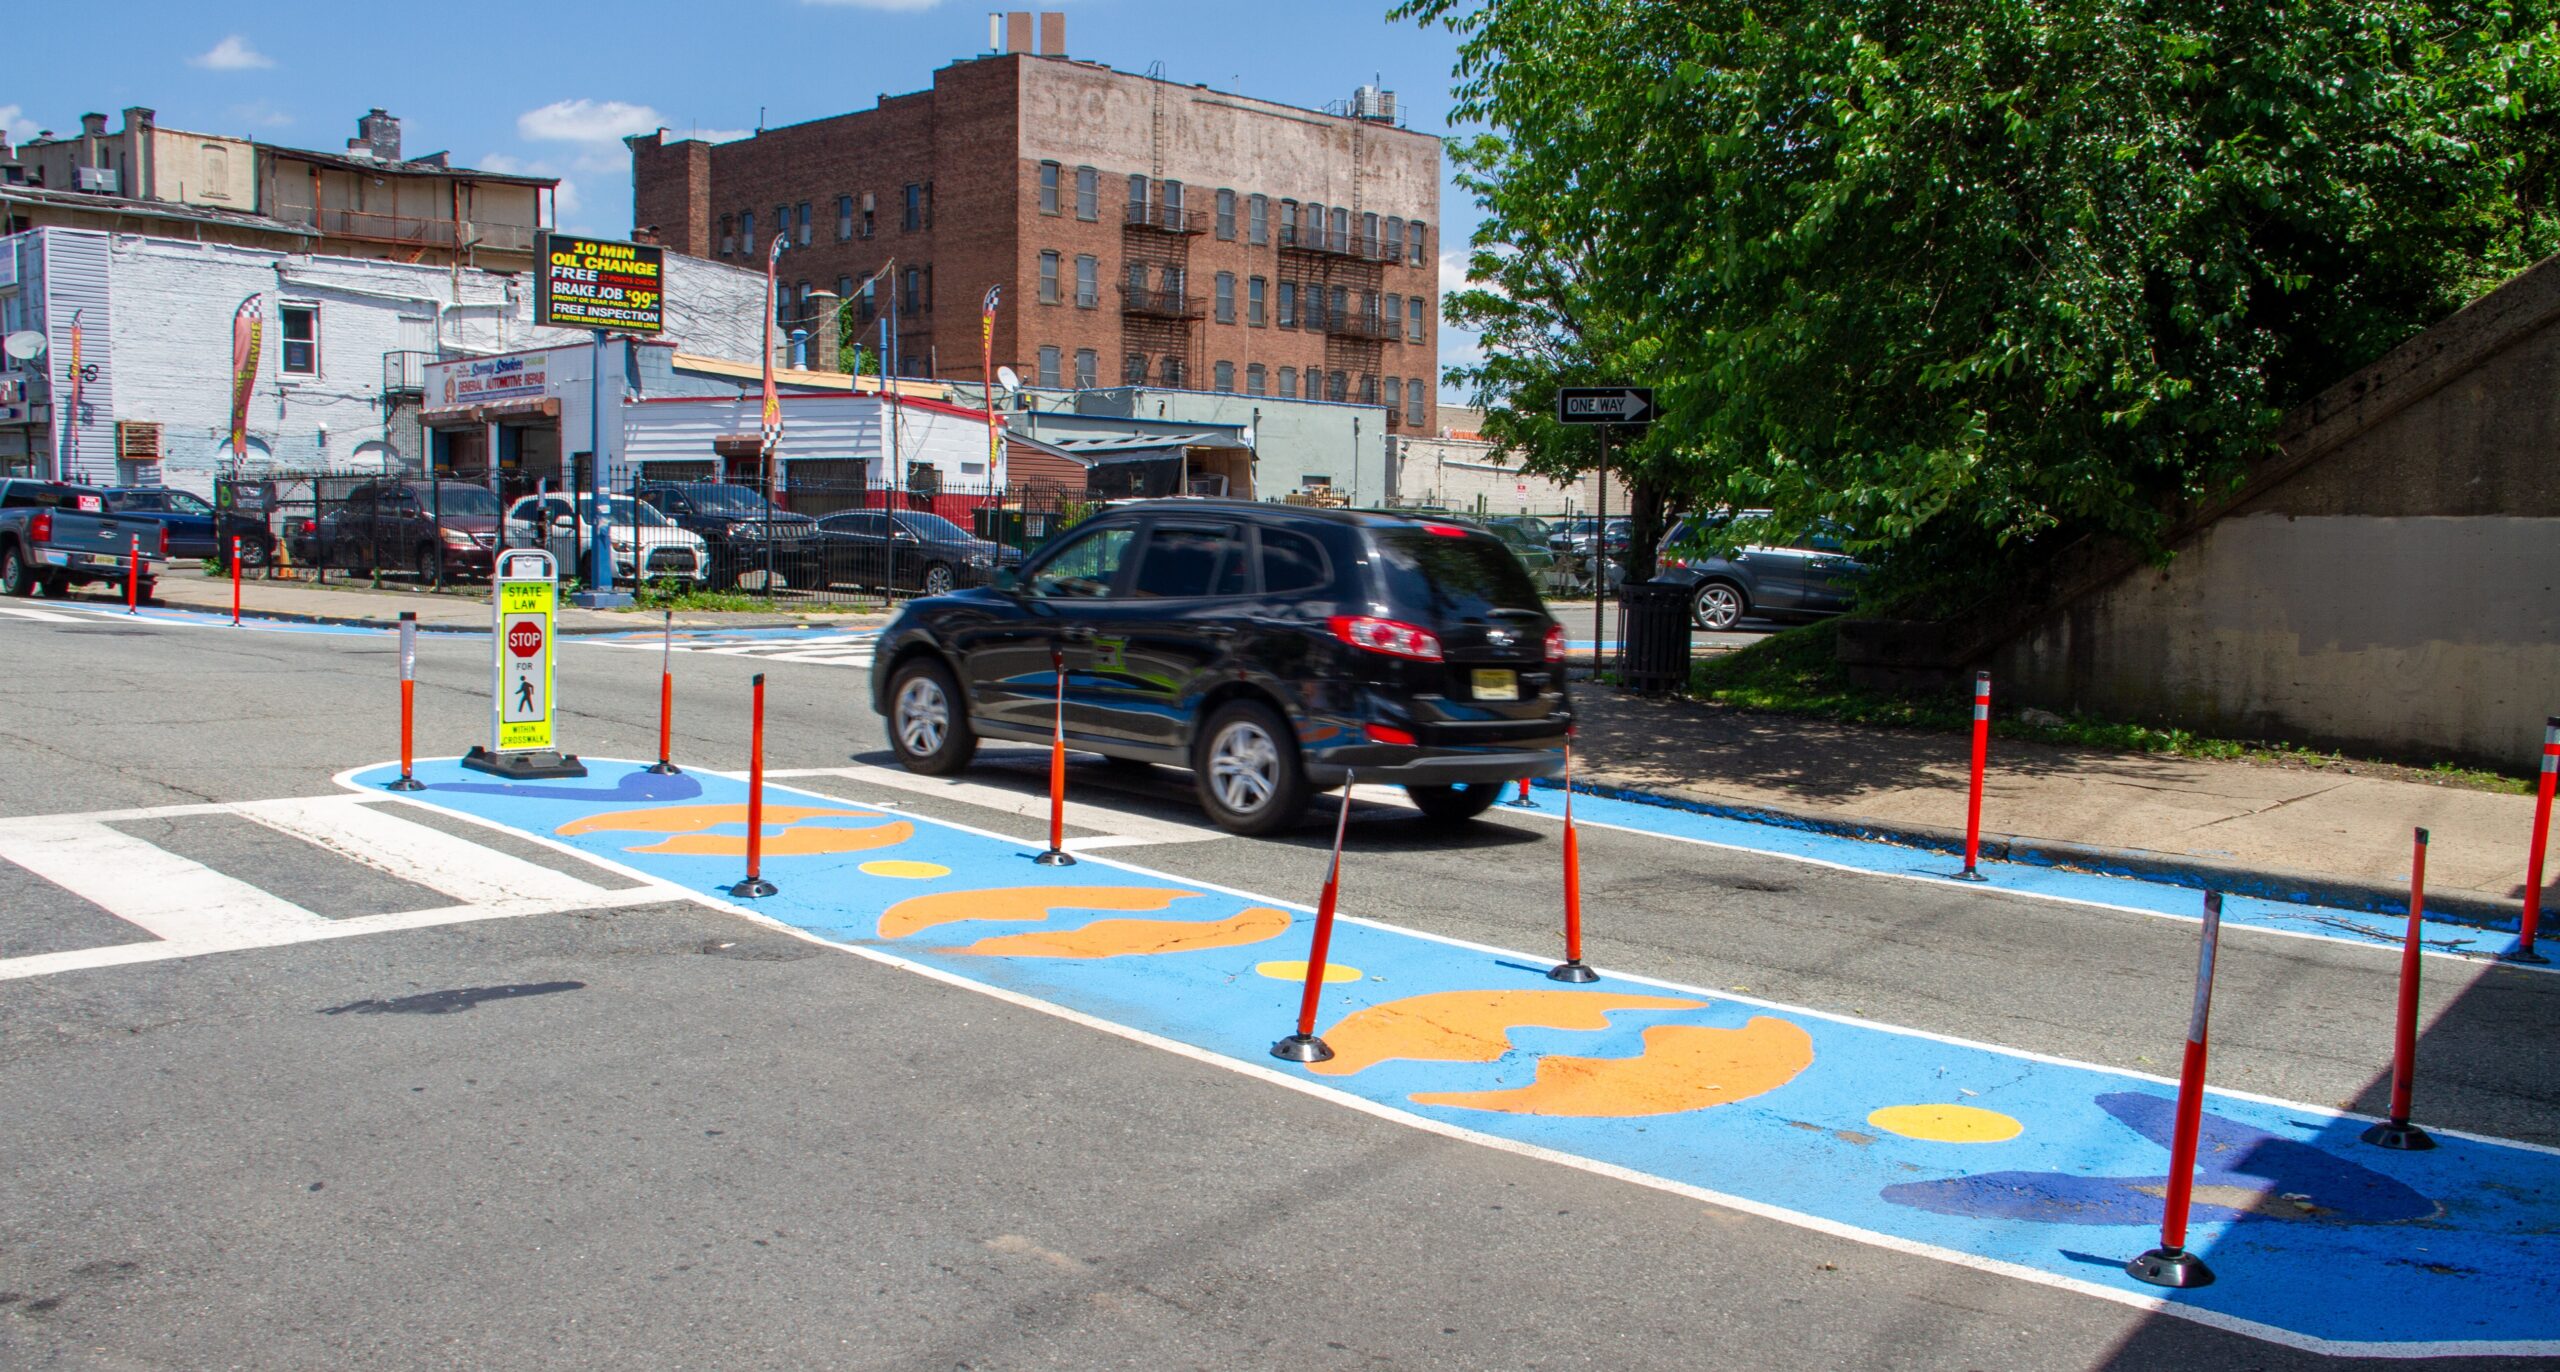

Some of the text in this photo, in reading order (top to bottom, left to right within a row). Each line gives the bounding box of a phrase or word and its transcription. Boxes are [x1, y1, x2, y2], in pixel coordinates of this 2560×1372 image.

[573, 241, 635, 260] 10 MIN
[550, 252, 658, 276] OIL CHANGE
[551, 266, 599, 281] FREE
[552, 281, 596, 297] BRAKE
[597, 286, 624, 300] JOB
[578, 296, 589, 304] OR
[590, 297, 608, 305] REAR
[553, 303, 586, 315] FREE
[587, 306, 659, 322] INSPECTION
[245, 322, 262, 378] SERVICE
[458, 371, 546, 393] GENERAL AUTOMOTIVE REPAIR
[1570, 398, 1625, 412] ONE WAY
[508, 586, 542, 597] STATE
[513, 600, 537, 610] LAW
[509, 632, 541, 648] STOP
[516, 662, 533, 671] FOR
[512, 725, 536, 734] WITHIN
[503, 734, 544, 746] CROSSWALK
